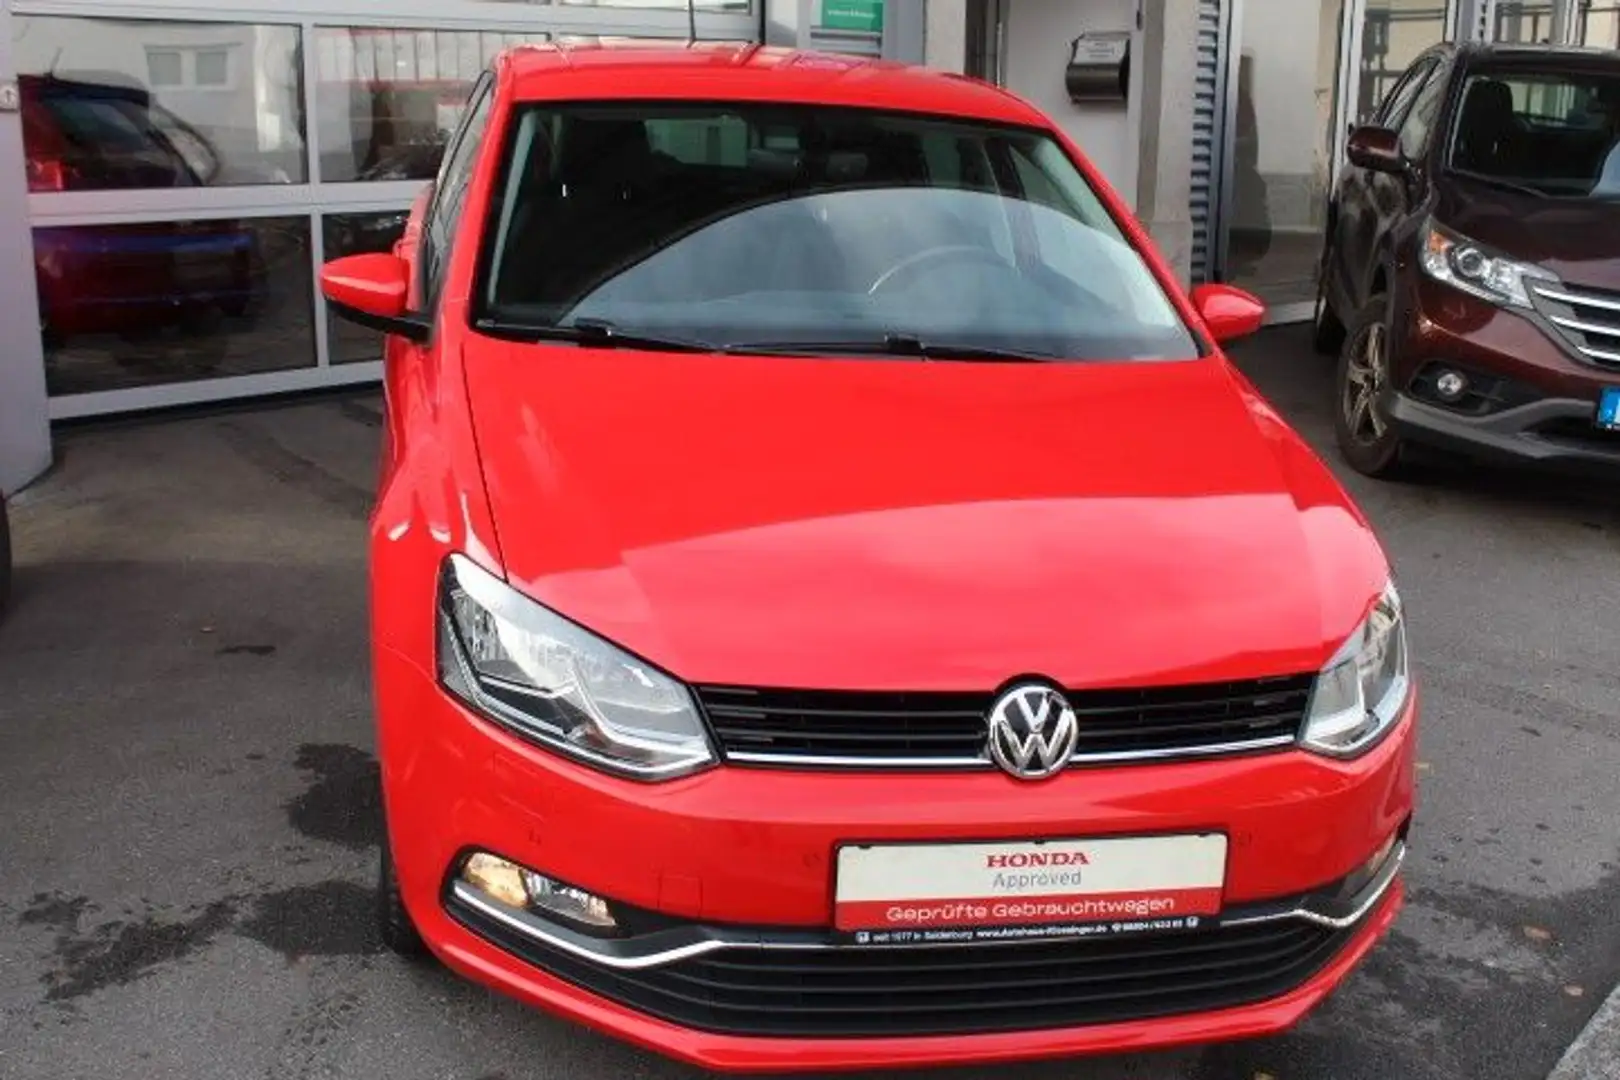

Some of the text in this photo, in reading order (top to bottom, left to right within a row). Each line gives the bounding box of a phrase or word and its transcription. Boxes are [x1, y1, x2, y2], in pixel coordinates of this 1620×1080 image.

[990, 686, 1078, 779] VW
[986, 851, 1090, 868] HONDA
[992, 869, 1083, 890] Approved
[886, 896, 1176, 922] Geprüfte Gebrauchtwagen
